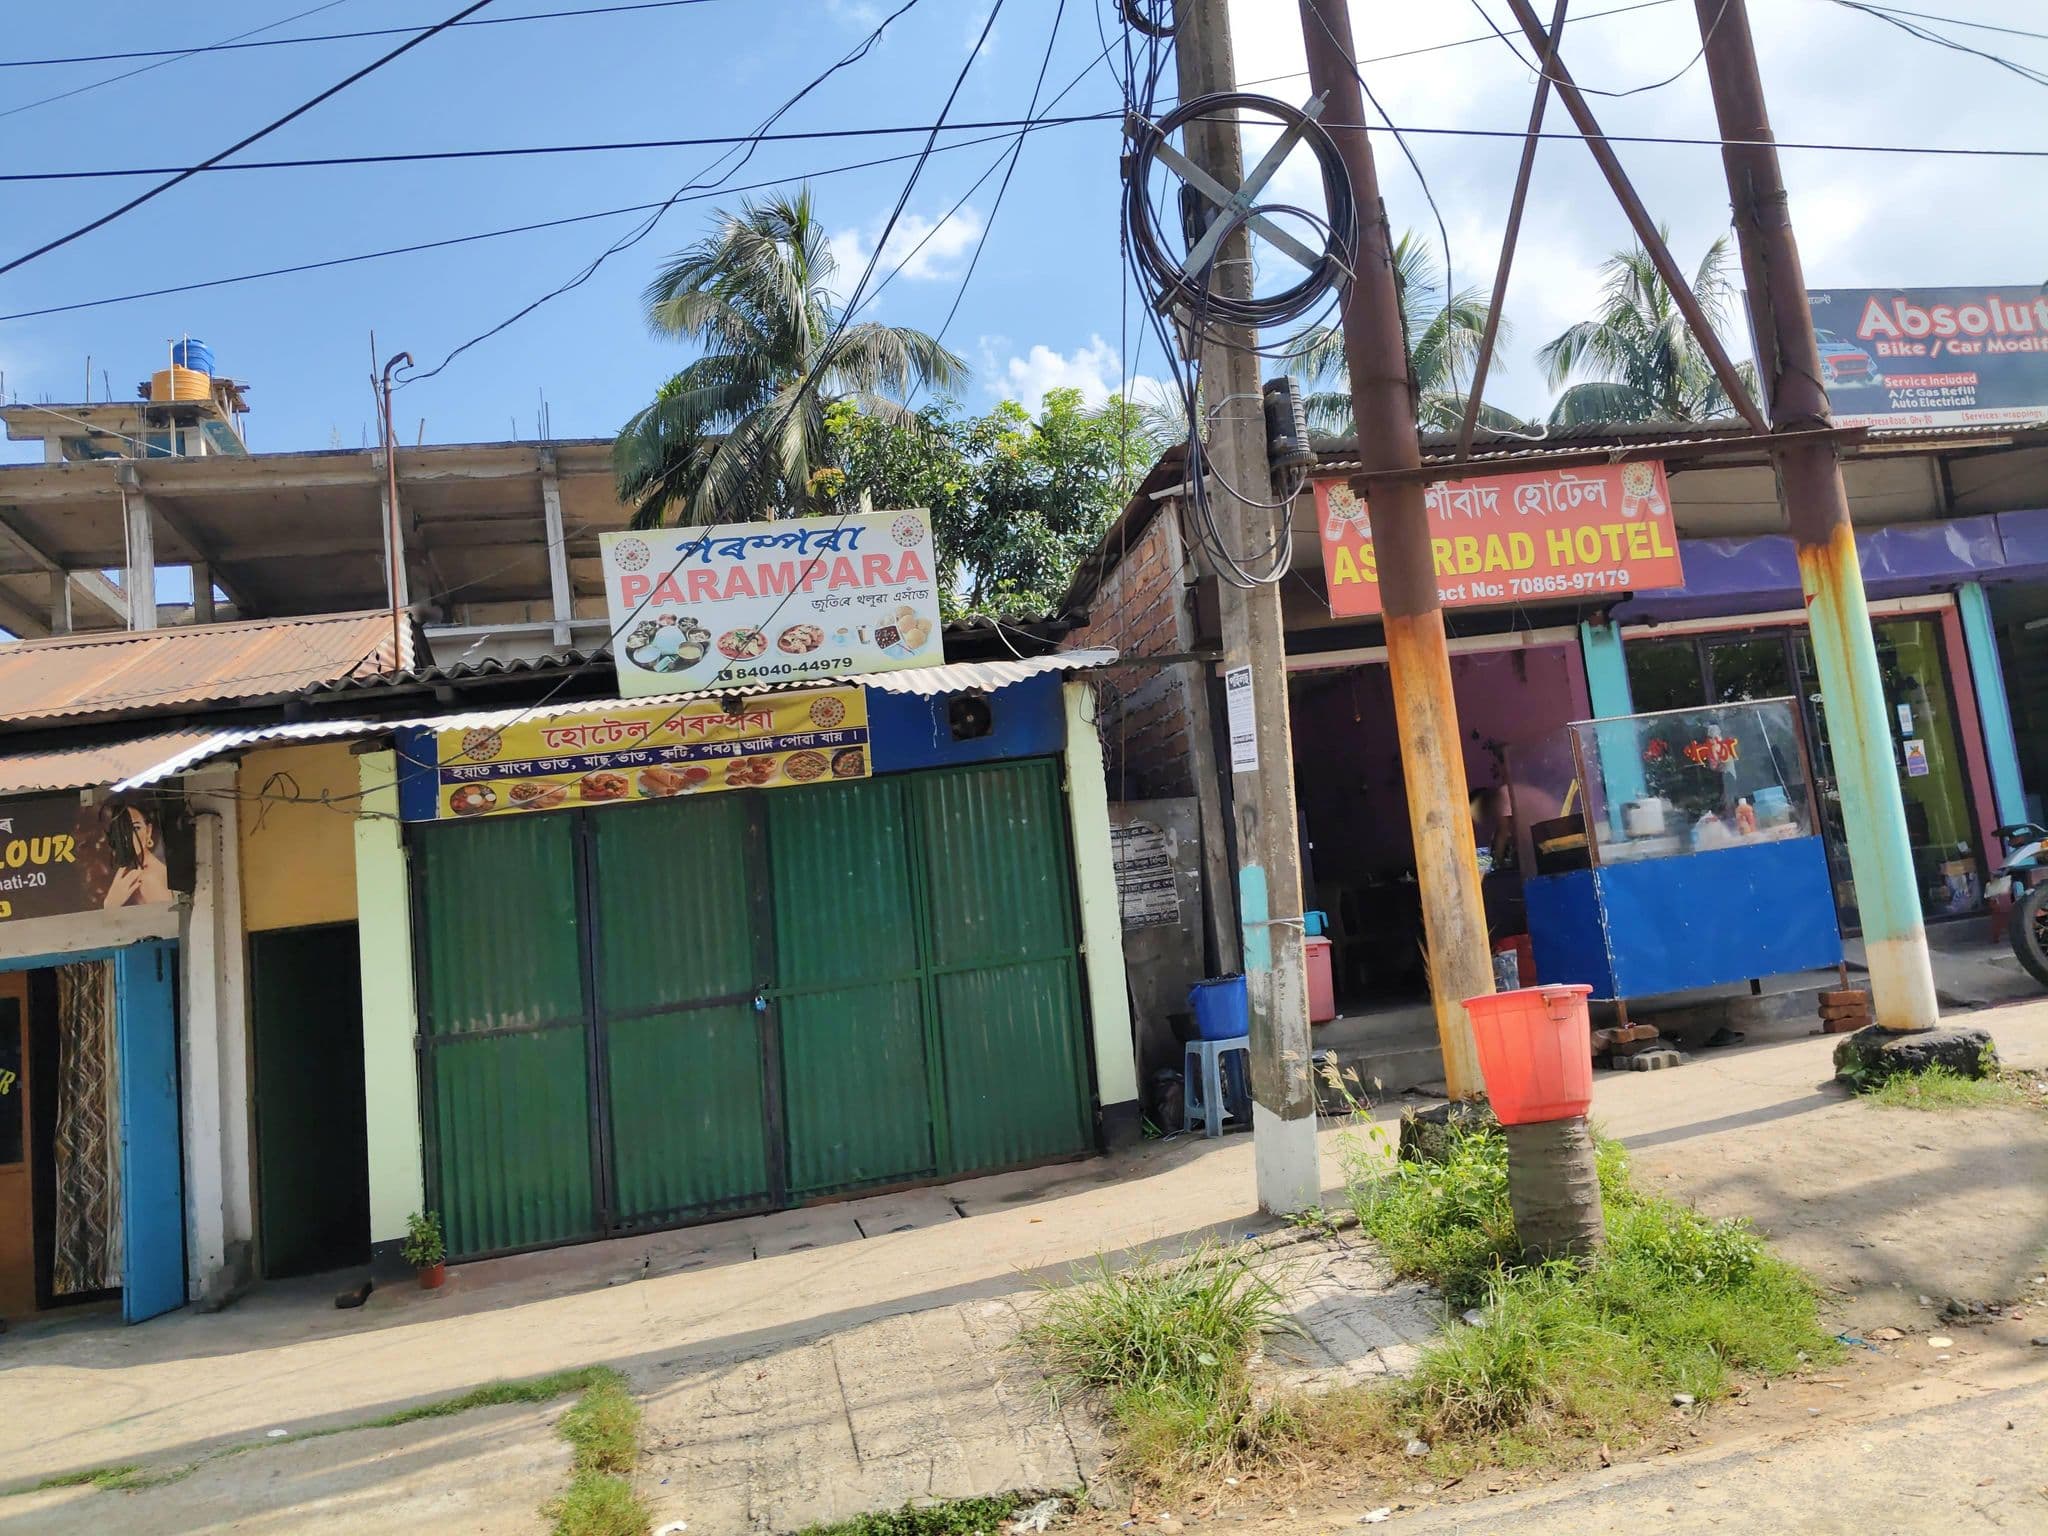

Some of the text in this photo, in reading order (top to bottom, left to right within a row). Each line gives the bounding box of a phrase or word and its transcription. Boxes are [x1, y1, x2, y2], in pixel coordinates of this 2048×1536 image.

[1876, 341, 1926, 357] Bike
[1947, 340, 1981, 355] Car
[1884, 374, 1977, 387] Service Included
[1916, 388, 1939, 397] Gas
[1941, 386, 1976, 395] Refill
[1891, 396, 1976, 408] Auto Electricals
[1513, 470, 1608, 516] হোটেল
[675, 525, 866, 564] পৰম্পৰা
[1333, 521, 1674, 586] ASRBAD HOTEL
[618, 550, 929, 609] PARAMPARA
[1471, 581, 1505, 599] No:
[1509, 570, 1631, 596] 70865-97179
[736, 657, 853, 680] 84040-44979
[541, 718, 650, 750] হোটেল
[499, 760, 532, 776] মাংস
[538, 756, 577, 771] ভাত,
[617, 749, 653, 765] ভাত,
[743, 737, 774, 751] আদি
